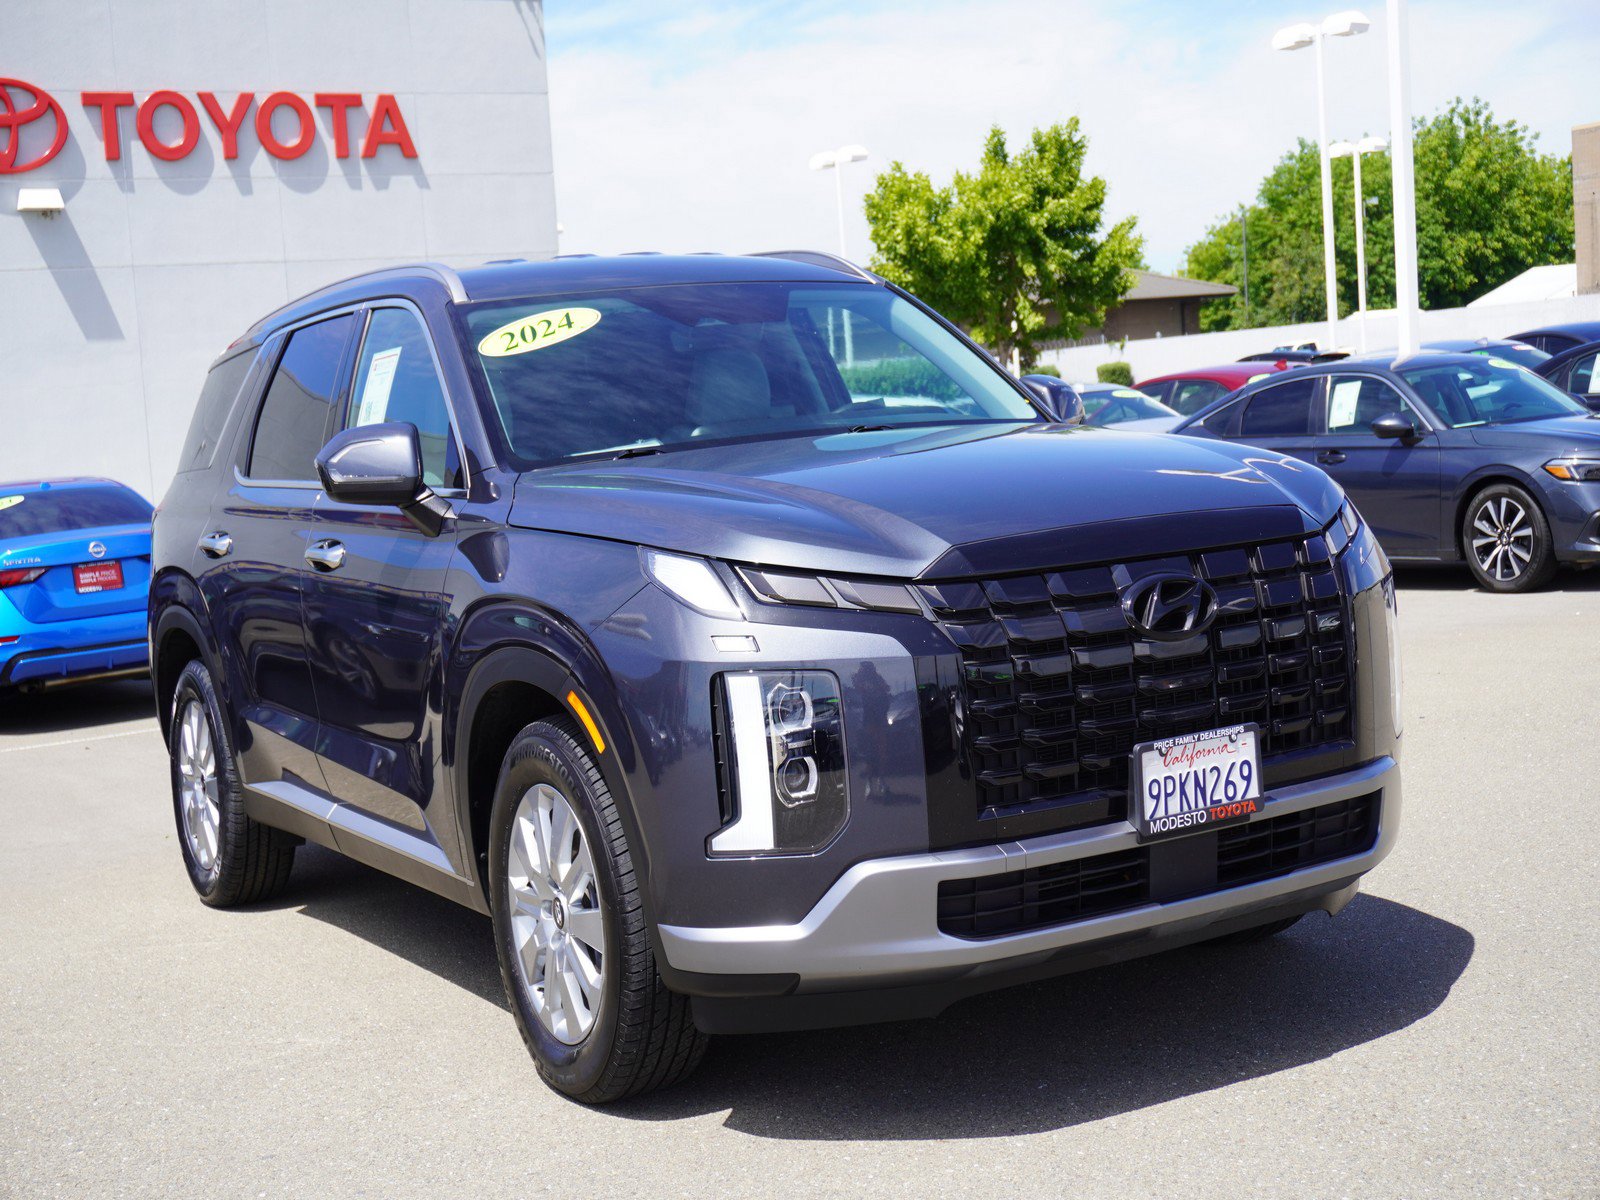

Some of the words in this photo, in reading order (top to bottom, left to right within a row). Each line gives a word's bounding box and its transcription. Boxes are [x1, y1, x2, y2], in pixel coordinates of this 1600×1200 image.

[81, 89, 419, 161] TOYOTA
[500, 312, 575, 352] 2024
[1153, 740, 1174, 749] PRICE
[1175, 734, 1199, 746] FAMILY
[1200, 725, 1245, 741] DEALERSHIPS
[1163, 742, 1236, 768] California
[1148, 759, 1252, 820] 9PKN269
[1150, 810, 1207, 834] MODESTO
[1210, 800, 1257, 820] TOYOTA
